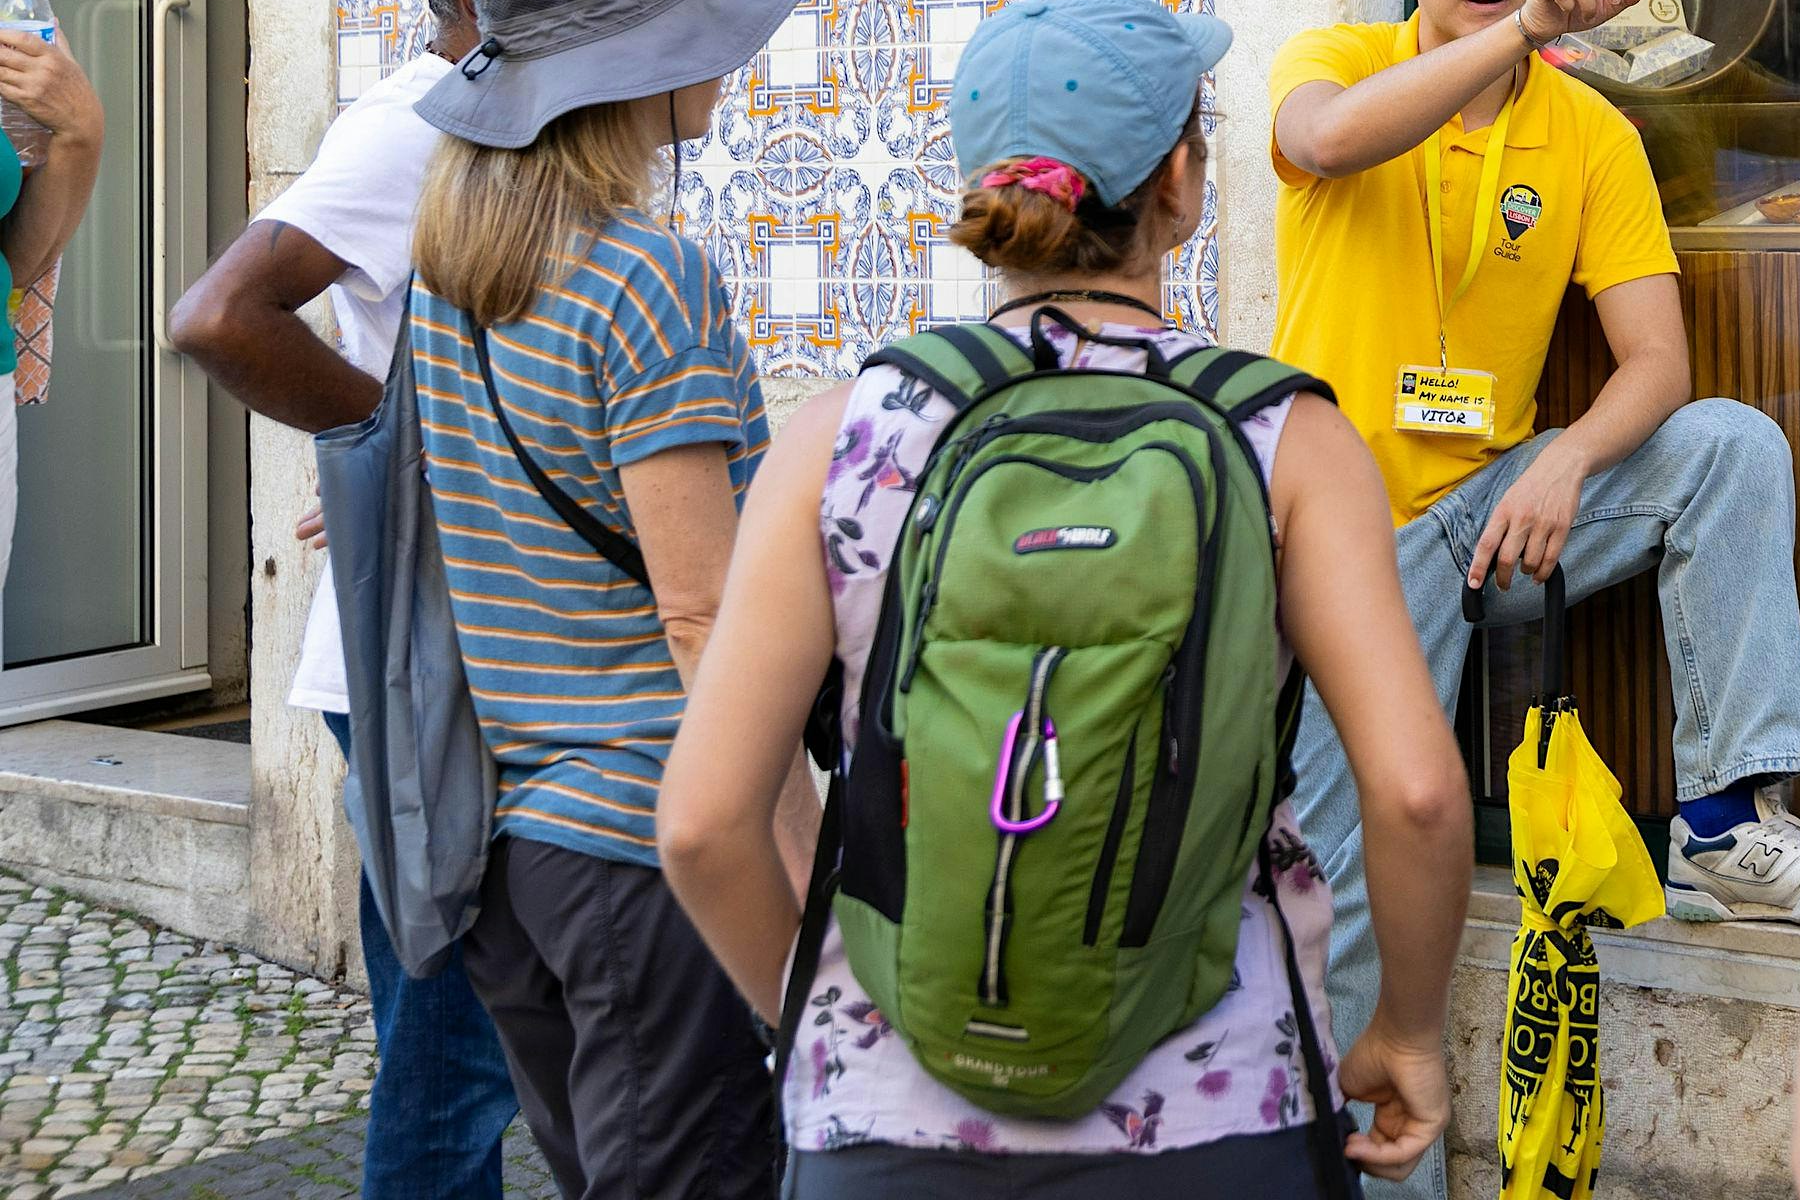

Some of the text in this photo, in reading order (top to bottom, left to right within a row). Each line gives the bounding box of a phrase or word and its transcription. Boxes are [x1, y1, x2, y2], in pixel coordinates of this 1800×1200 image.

[1508, 202, 1537, 216] DISCOVER
[1509, 211, 1531, 223] LISBON
[1501, 238, 1521, 251] Tour
[1494, 247, 1521, 262] Guide
[1420, 376, 1459, 388] HELLO!
[1440, 394, 1470, 403] NAME
[1422, 409, 1466, 424] VITOR
